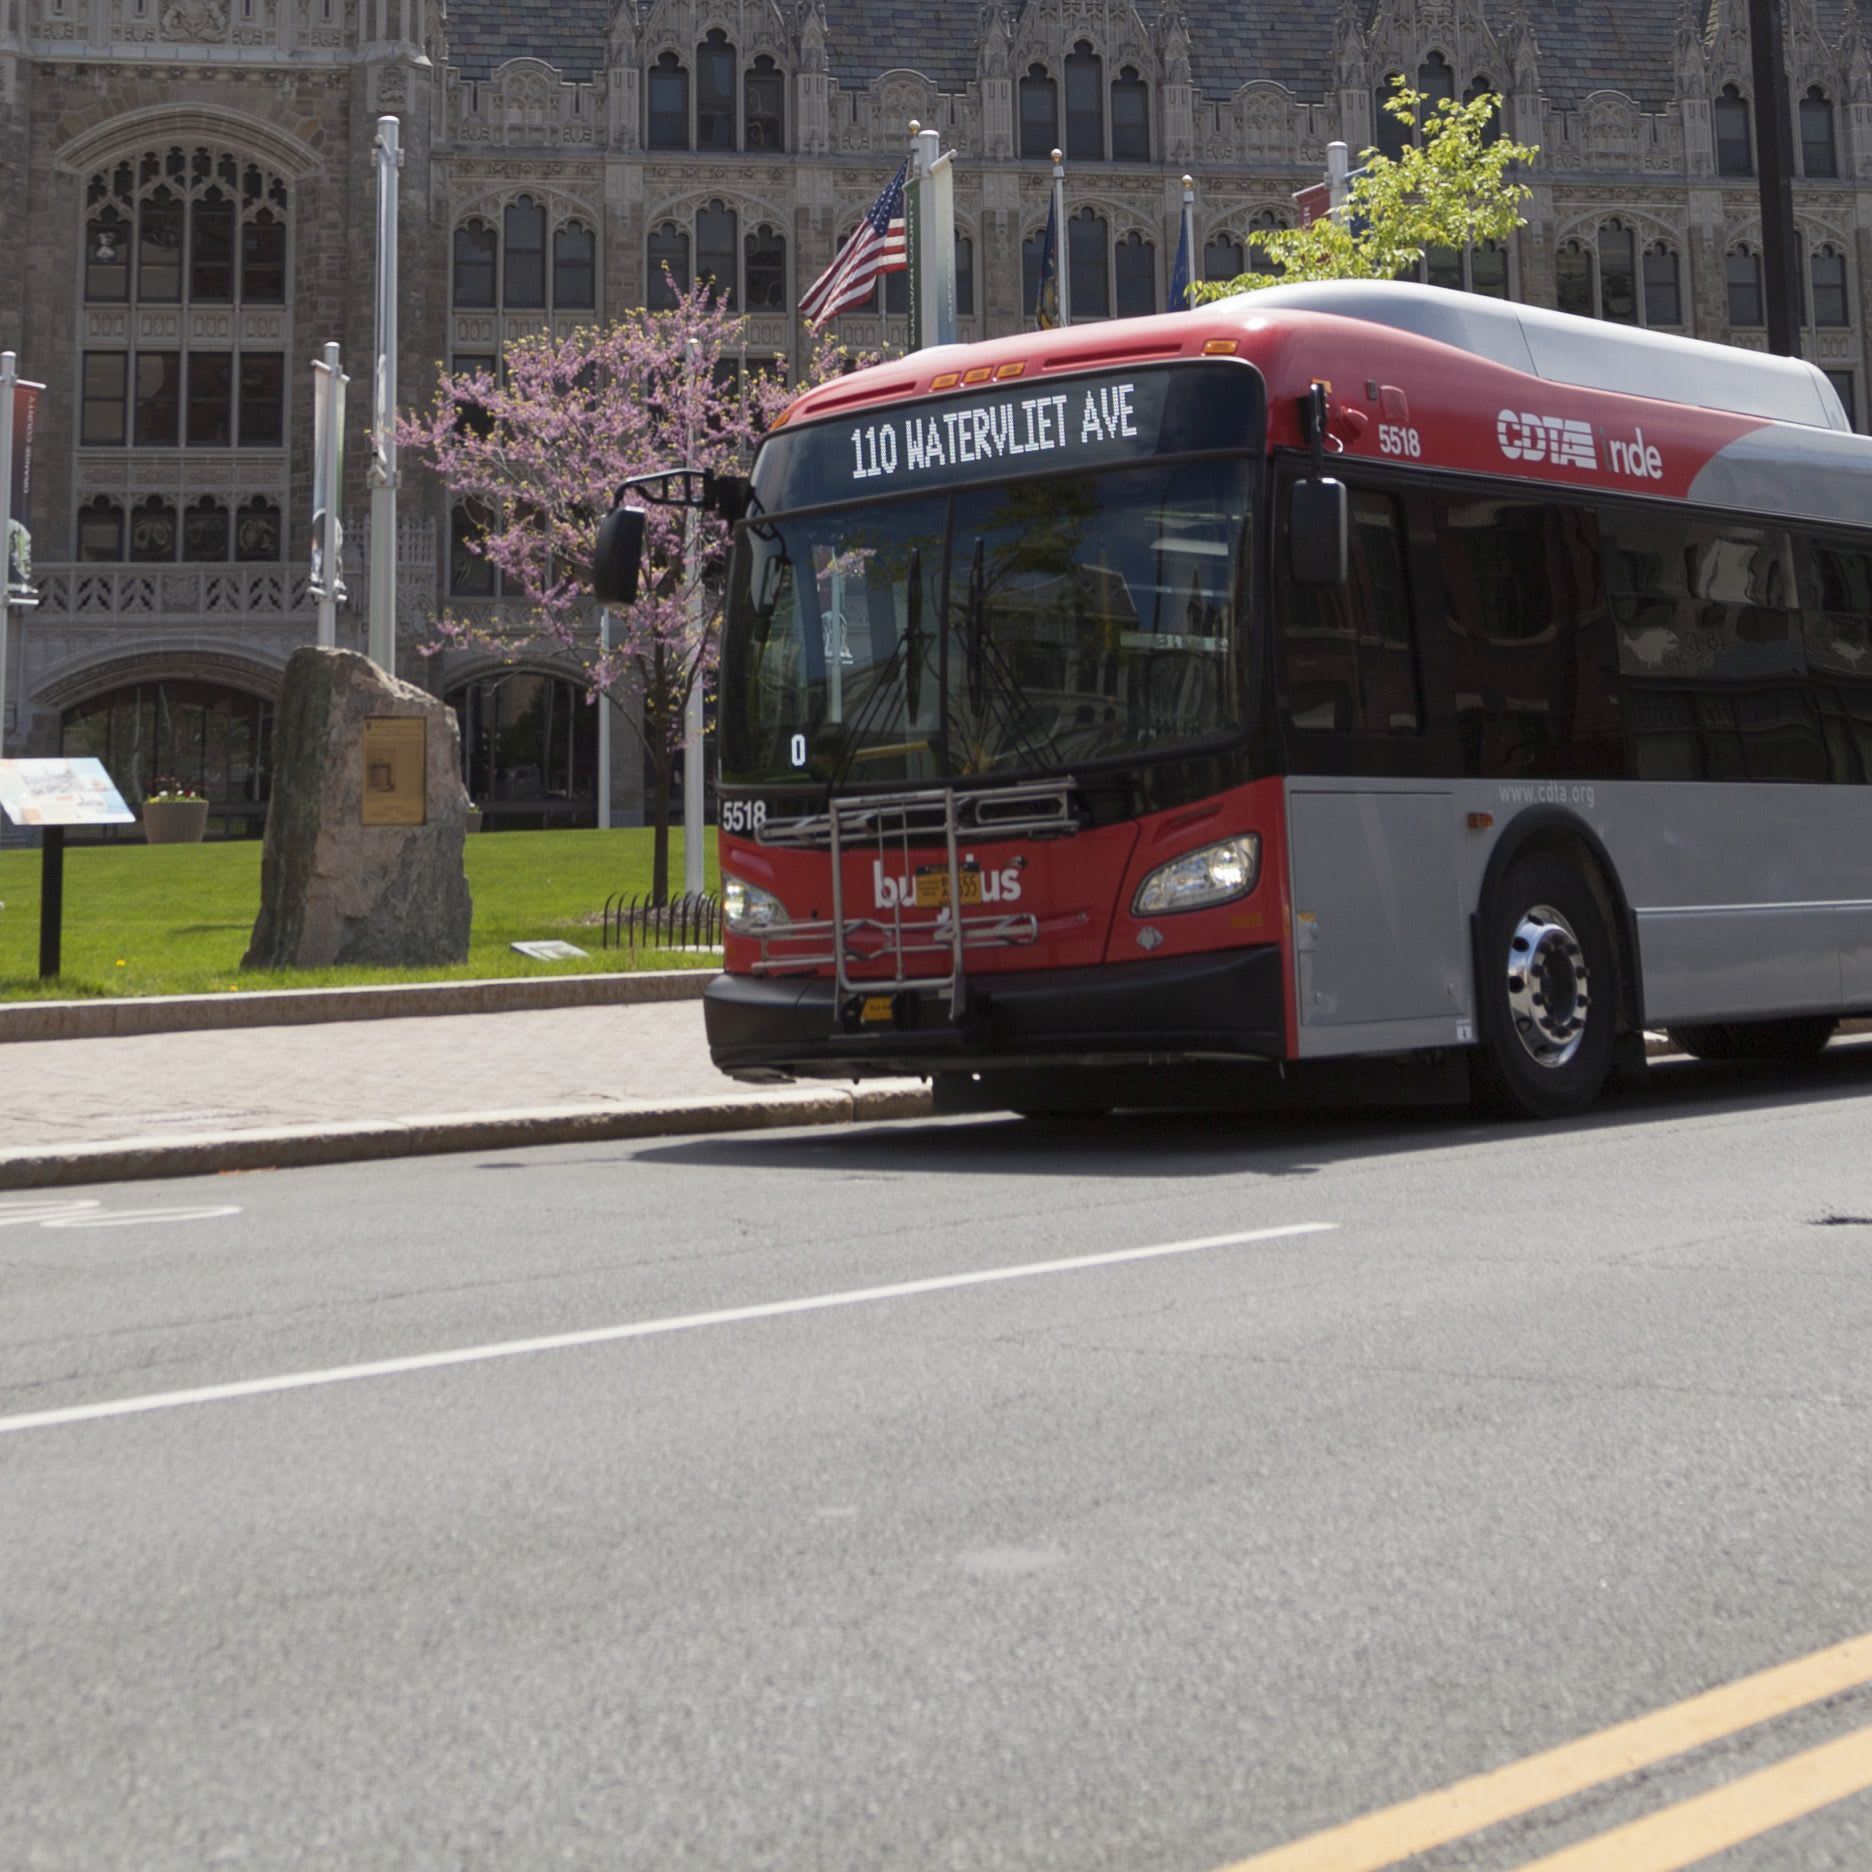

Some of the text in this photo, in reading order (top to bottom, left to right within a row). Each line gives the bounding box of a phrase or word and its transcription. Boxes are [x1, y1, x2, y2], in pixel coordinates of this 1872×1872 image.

[851, 384, 1137, 479] 110 WATERVLIET AVE
[1379, 423, 1421, 459] 5518
[1496, 409, 1598, 470] CDTA
[1498, 780, 1595, 809] www.cdta.org
[722, 799, 767, 832] 5518
